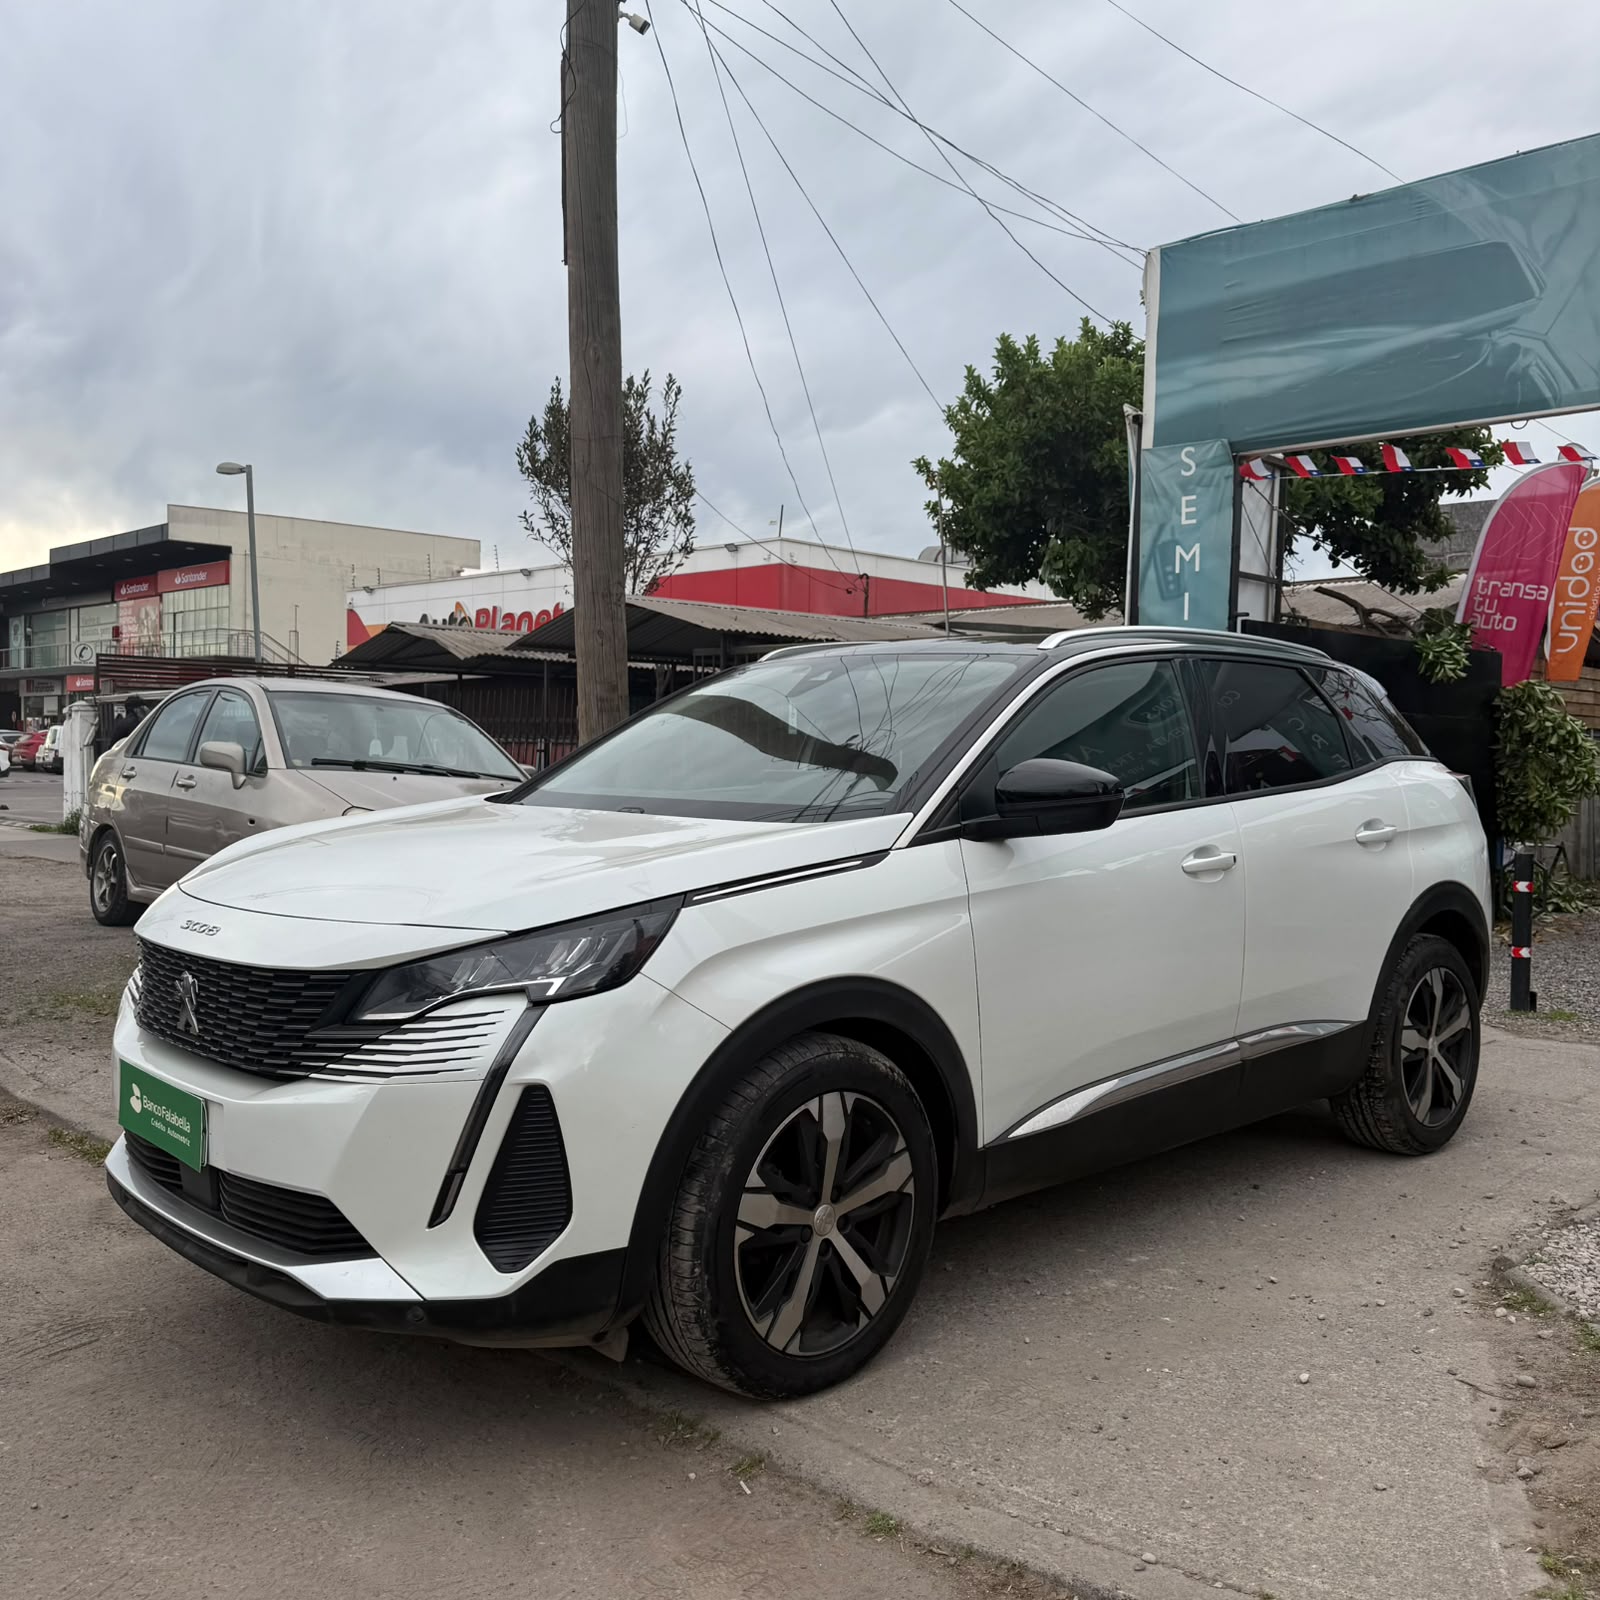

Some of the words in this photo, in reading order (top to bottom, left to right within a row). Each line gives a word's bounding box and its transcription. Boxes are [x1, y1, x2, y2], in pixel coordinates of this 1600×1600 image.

[181, 571, 207, 583] Santander
[126, 582, 149, 594] Santander
[1477, 576, 1549, 600] transa
[1556, 527, 1597, 653] unidad
[1474, 594, 1498, 614] tu
[1470, 612, 1517, 632] auto
[180, 920, 221, 937] 3008
